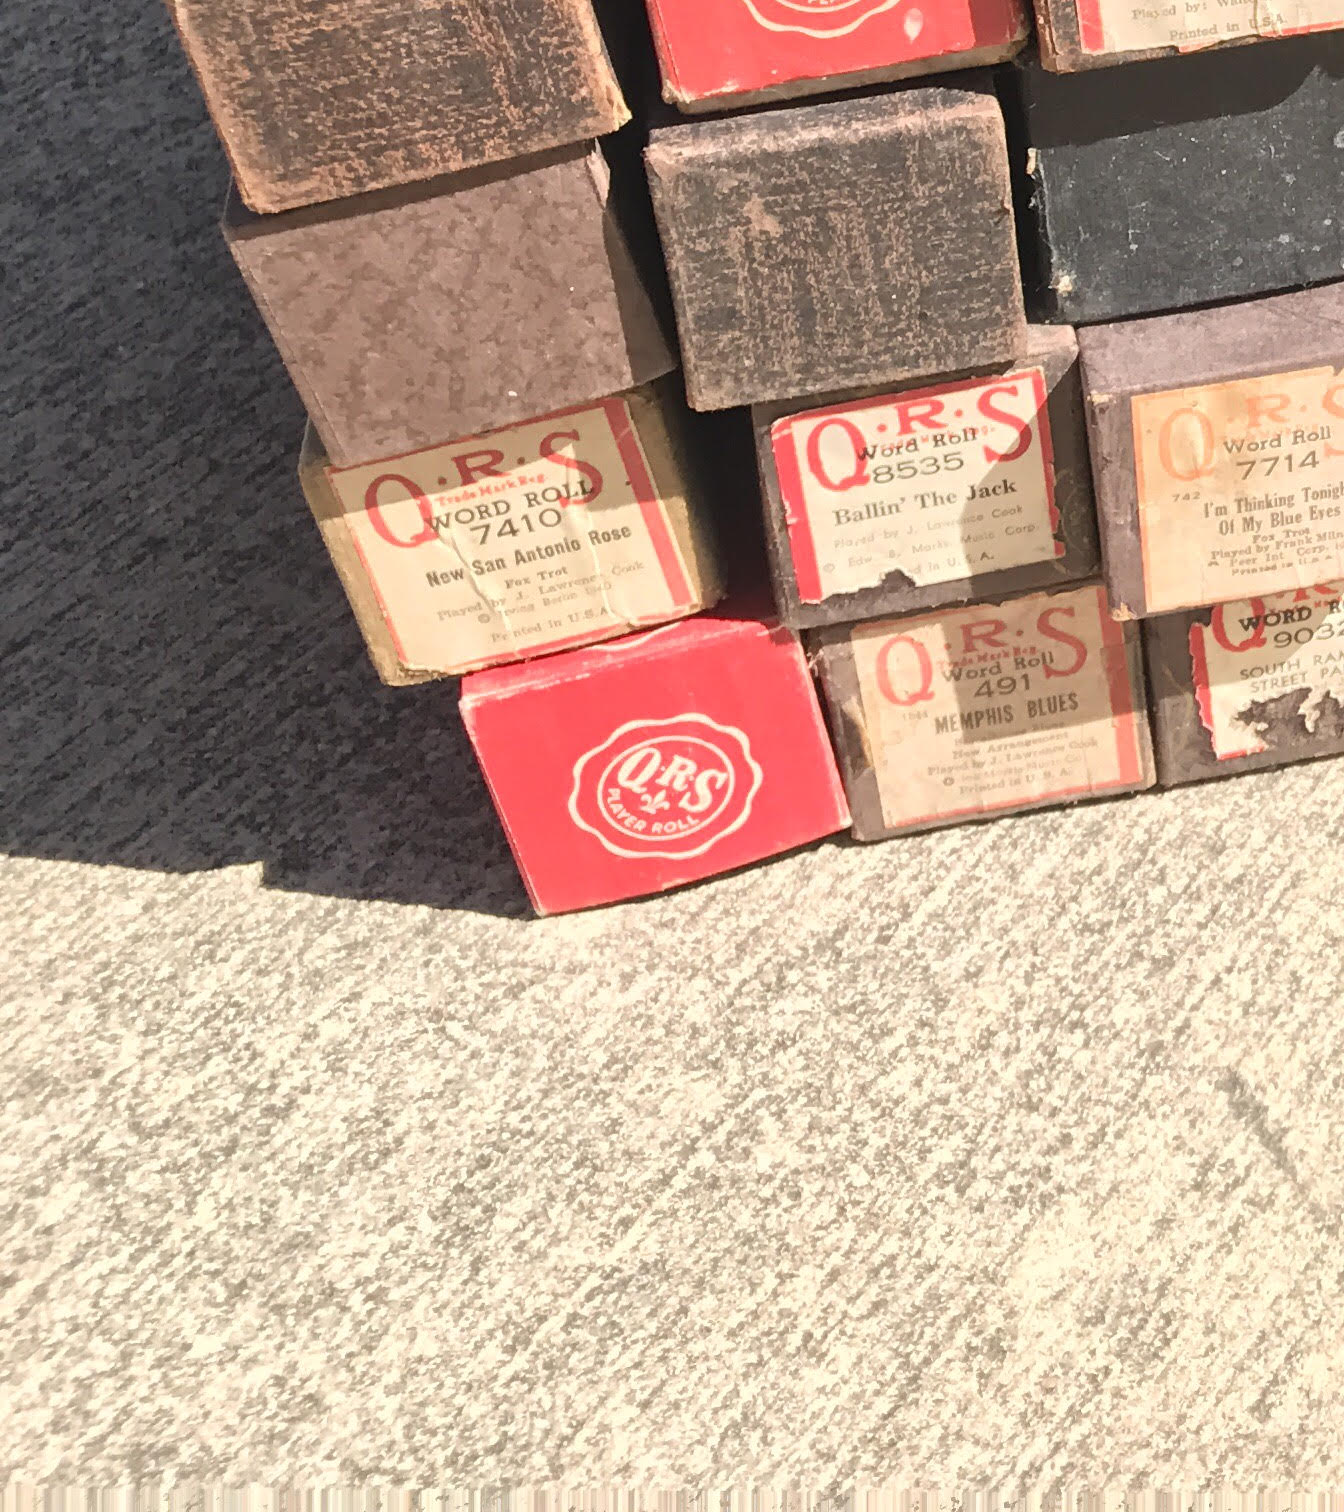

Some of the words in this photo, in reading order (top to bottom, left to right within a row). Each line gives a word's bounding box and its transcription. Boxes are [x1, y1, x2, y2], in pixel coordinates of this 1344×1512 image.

[1223, 431, 1282, 454] Word
[1292, 426, 1331, 444] Roll
[872, 451, 965, 484] 8535
[1236, 450, 1320, 480] 7714
[426, 500, 511, 532] WORD
[524, 480, 596, 509] ROLL
[914, 491, 957, 511] The
[966, 479, 1017, 502] Jack
[1172, 491, 1201, 502] 742
[1234, 494, 1295, 514] Thinking
[470, 508, 562, 546] 7410
[1219, 519, 1235, 536] Of
[1242, 516, 1263, 533] My
[1270, 511, 1301, 528] Blue
[1309, 504, 1341, 521] Eyes
[426, 568, 465, 587] New
[472, 558, 507, 580] San
[514, 538, 582, 566] Antonio
[588, 525, 632, 546] Rose
[1239, 606, 1312, 632] WORD
[943, 662, 1001, 682] Word
[1015, 651, 1056, 671] Roll
[1240, 659, 1300, 679] SOUTH
[974, 674, 1031, 699] 491
[1251, 672, 1307, 693] STREET
[935, 704, 1014, 734] MEMPHIS
[1027, 693, 1079, 718] BLUES
